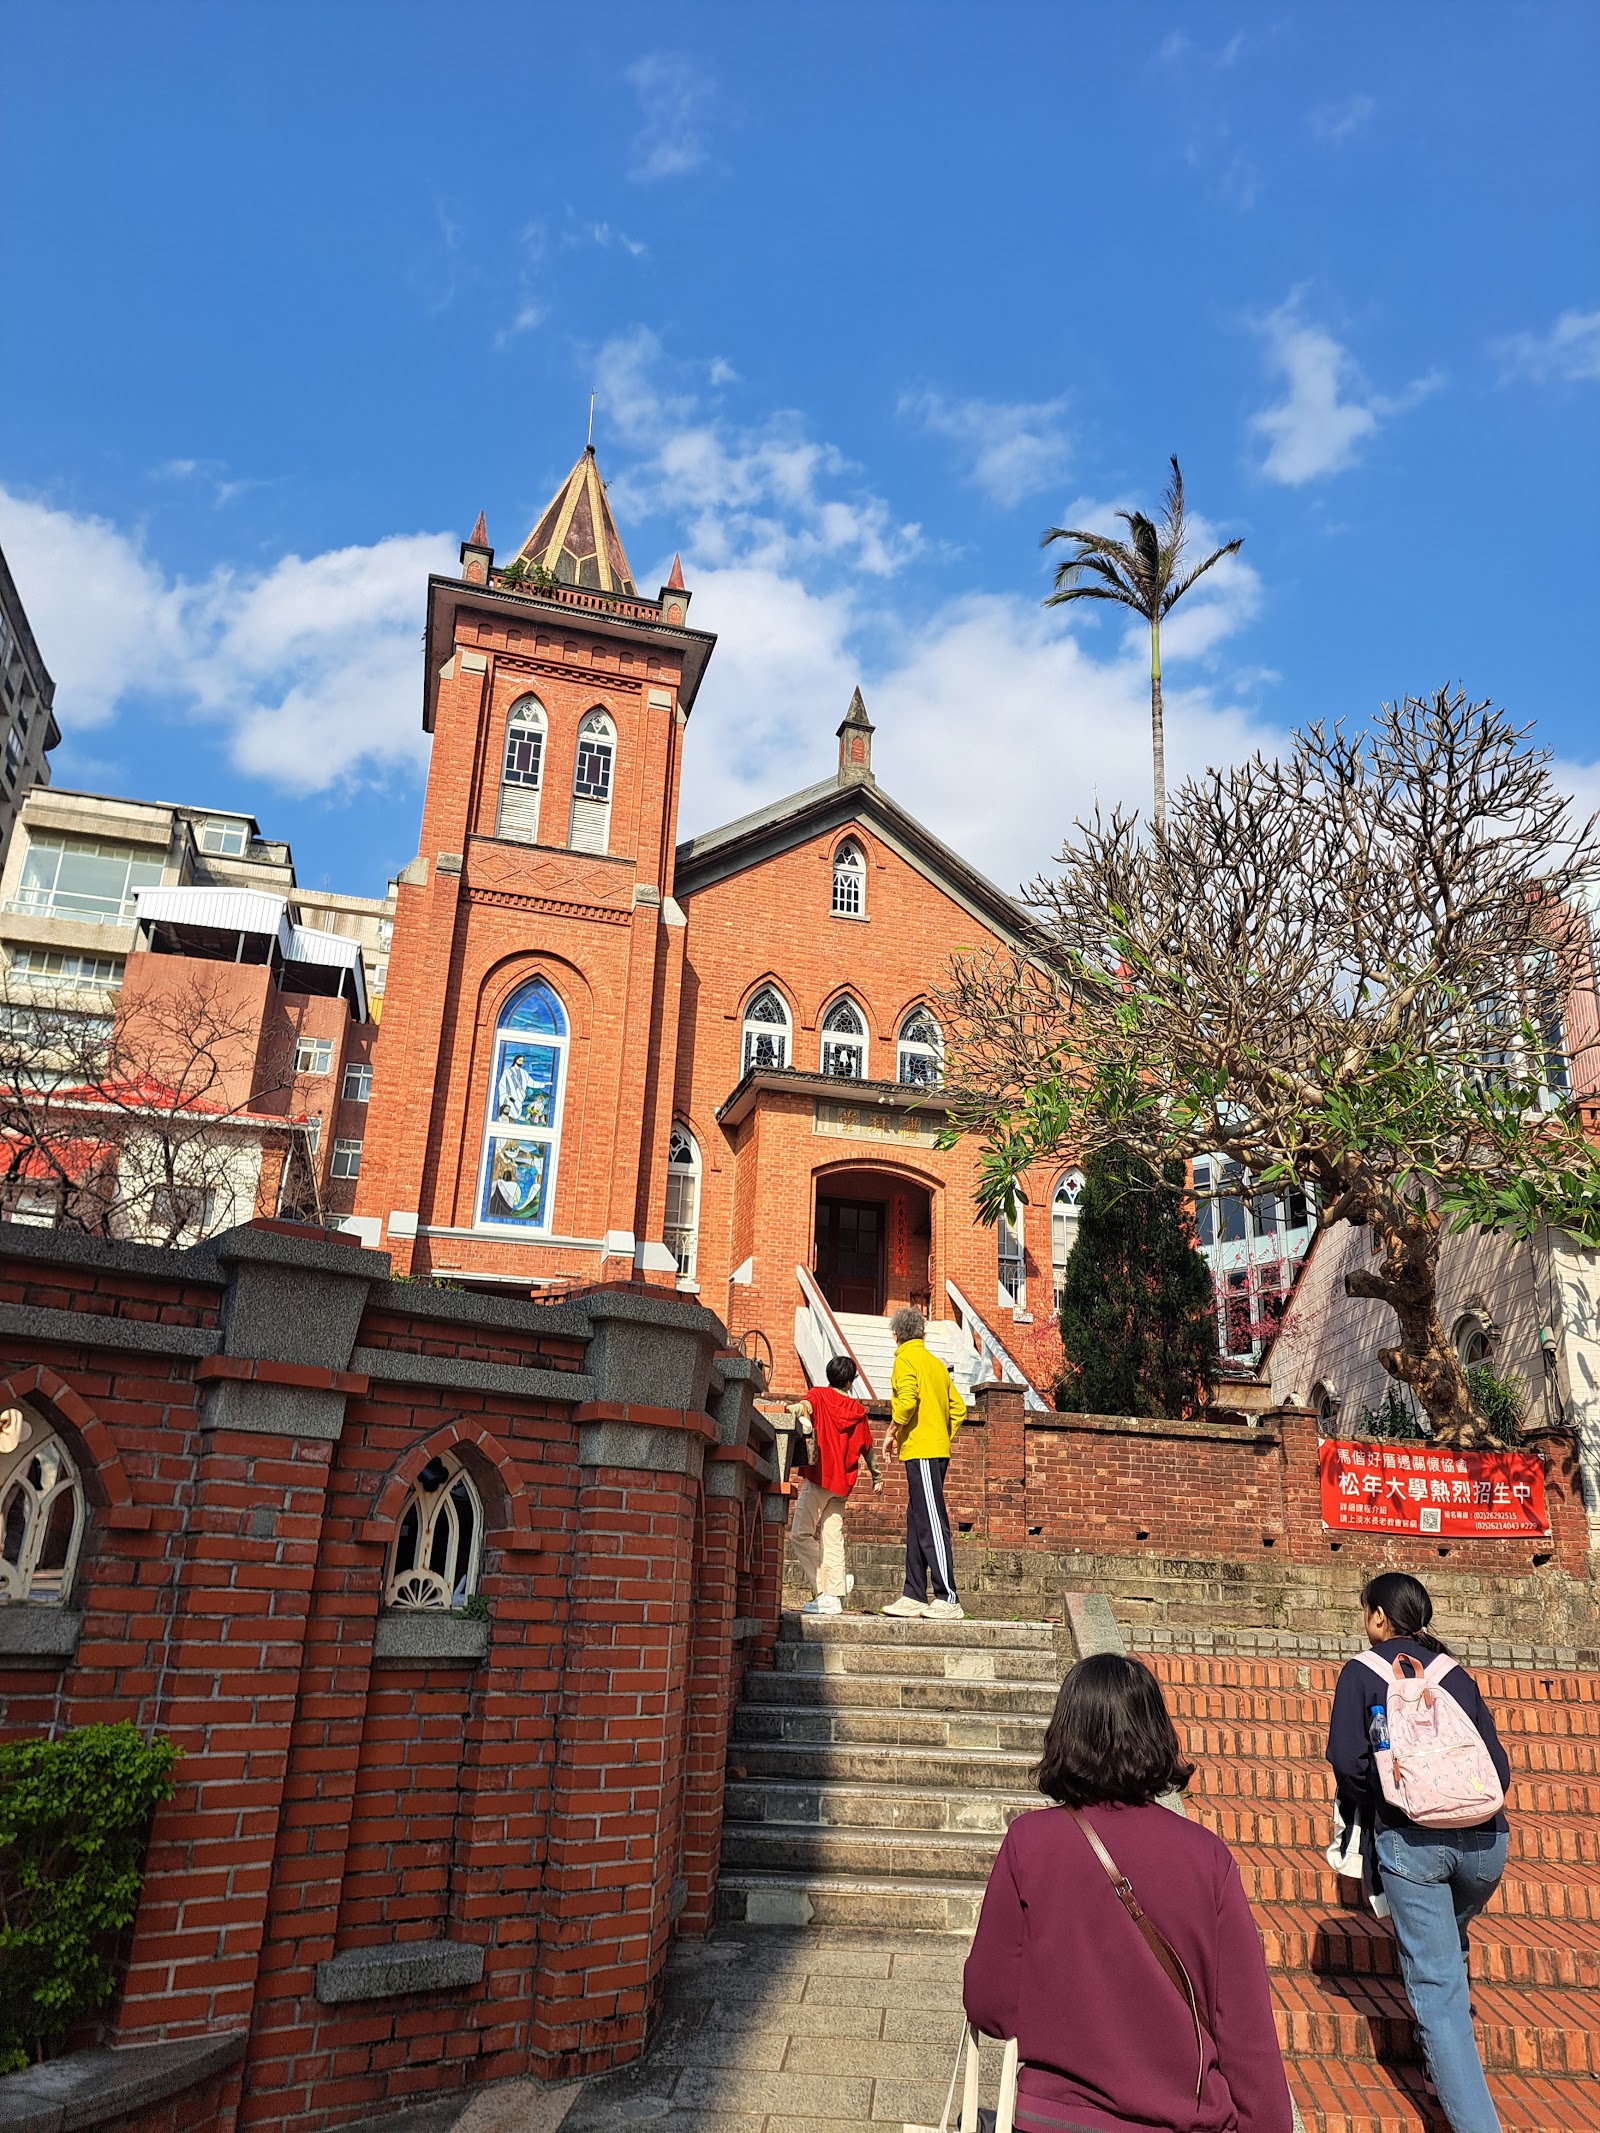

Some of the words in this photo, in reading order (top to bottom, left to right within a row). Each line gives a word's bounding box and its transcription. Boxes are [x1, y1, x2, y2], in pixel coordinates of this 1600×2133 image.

[1336, 1449, 1468, 1474] 馬偕好厝邊關懷協會
[1338, 1472, 1531, 1505] 松年大學熱烈招生中
[1339, 1502, 1388, 1515] 詳細課程介紹
[1339, 1514, 1418, 1529] 請上淡水長老教會官網
